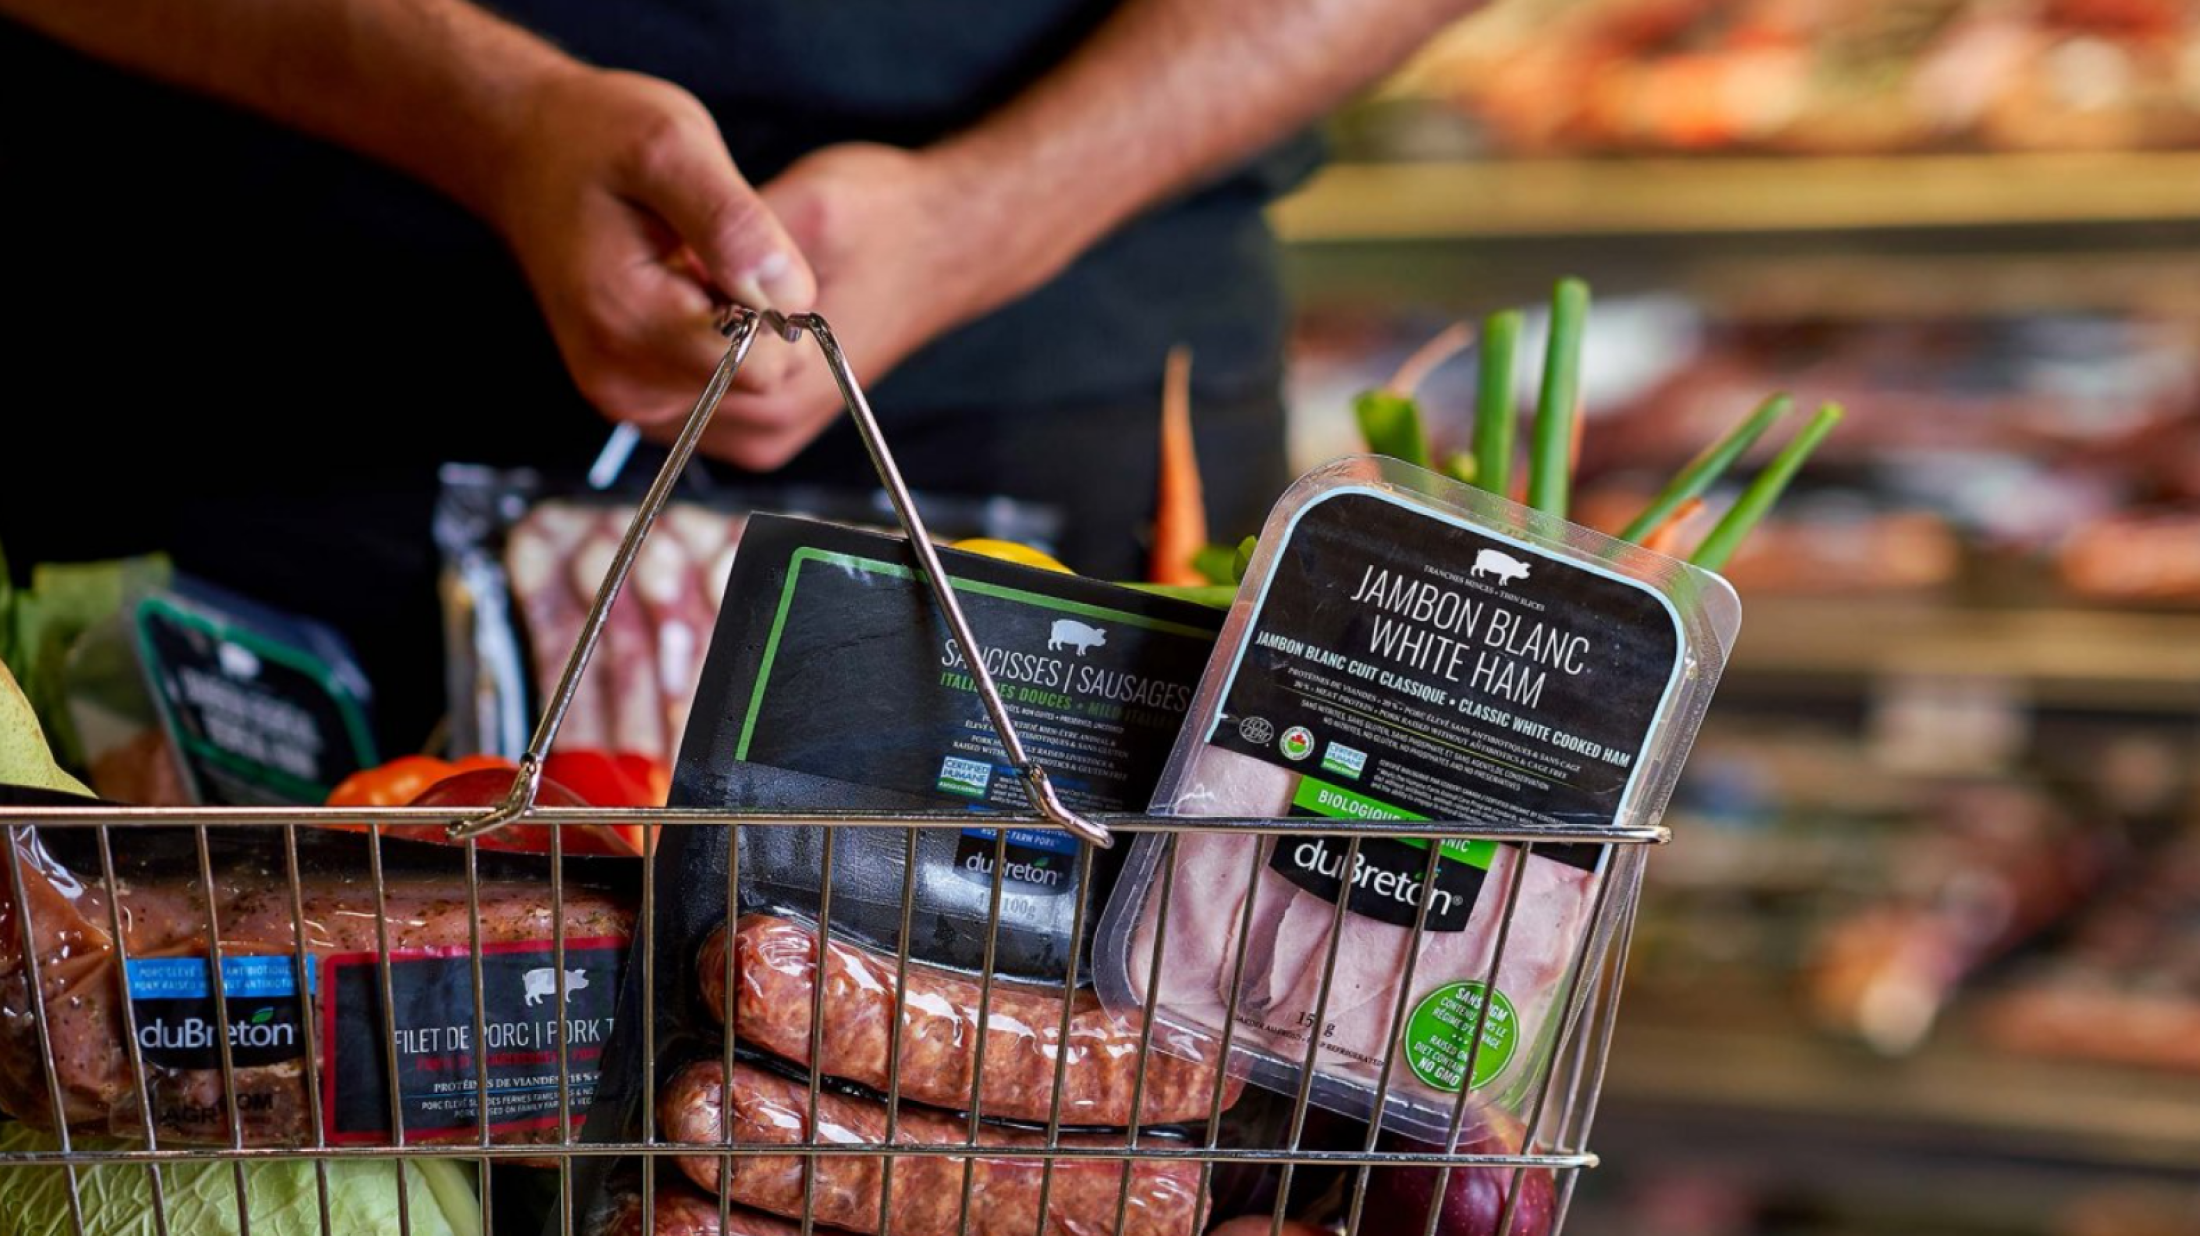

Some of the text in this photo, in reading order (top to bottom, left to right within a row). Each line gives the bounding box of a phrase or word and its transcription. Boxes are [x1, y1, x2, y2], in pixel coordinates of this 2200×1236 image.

[1351, 564, 1591, 676] JAMBON BLANC
[941, 638, 1063, 686] SACISSES
[1076, 665, 1190, 712] SAUSAGES
[1369, 615, 1546, 709] WHITE HAM
[940, 672, 1016, 699] ITALIES
[1019, 688, 1073, 711] DOUCES
[1087, 701, 1124, 720] MILD
[1254, 628, 1631, 769] JAMBON BLANC CUIT CLASSIQUE CLASSIC WHITE COOKED HAM
[943, 767, 987, 786] HUMANE
[945, 757, 989, 775] CERTIFIED
[966, 851, 1058, 886] dureton
[1456, 987, 1481, 1010] SANS
[140, 1018, 294, 1049] duBreton
[394, 1027, 441, 1054] FILET
[446, 1025, 470, 1051] DE
[546, 1019, 601, 1045] PORK
[1414, 1041, 1434, 1056] DIET
[434, 1078, 494, 1093] PROTÉINS
[1417, 1057, 1461, 1087] NO GMO
